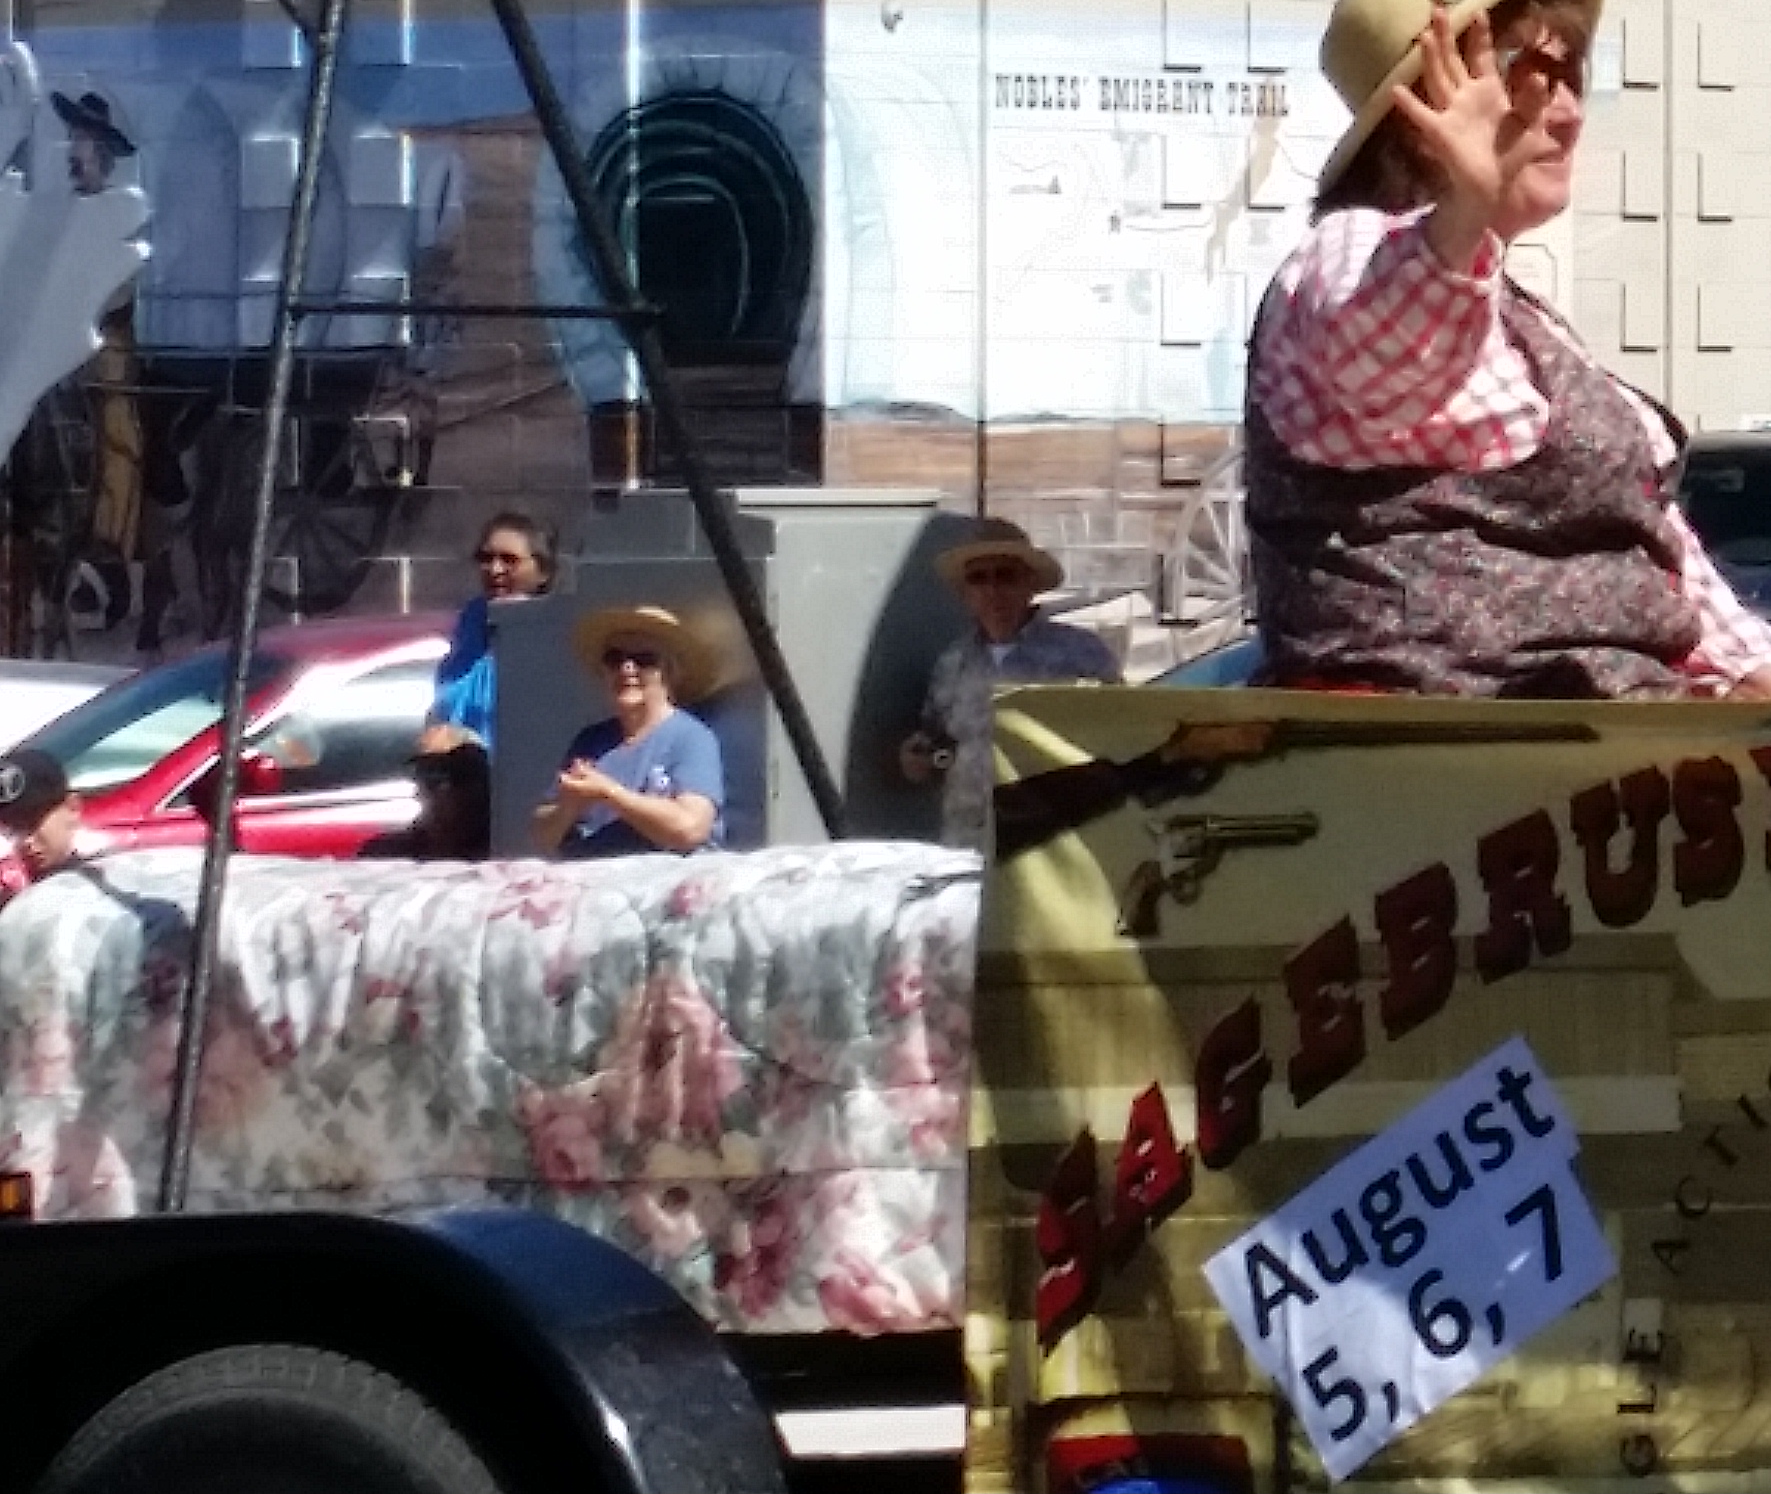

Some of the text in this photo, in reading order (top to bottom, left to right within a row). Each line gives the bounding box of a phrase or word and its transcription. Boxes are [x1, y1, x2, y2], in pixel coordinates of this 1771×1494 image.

[1098, 76, 1214, 114] EMIGRANT
[1243, 1060, 1557, 1340] August
[1301, 1186, 1568, 1444] 5, 6, 7
